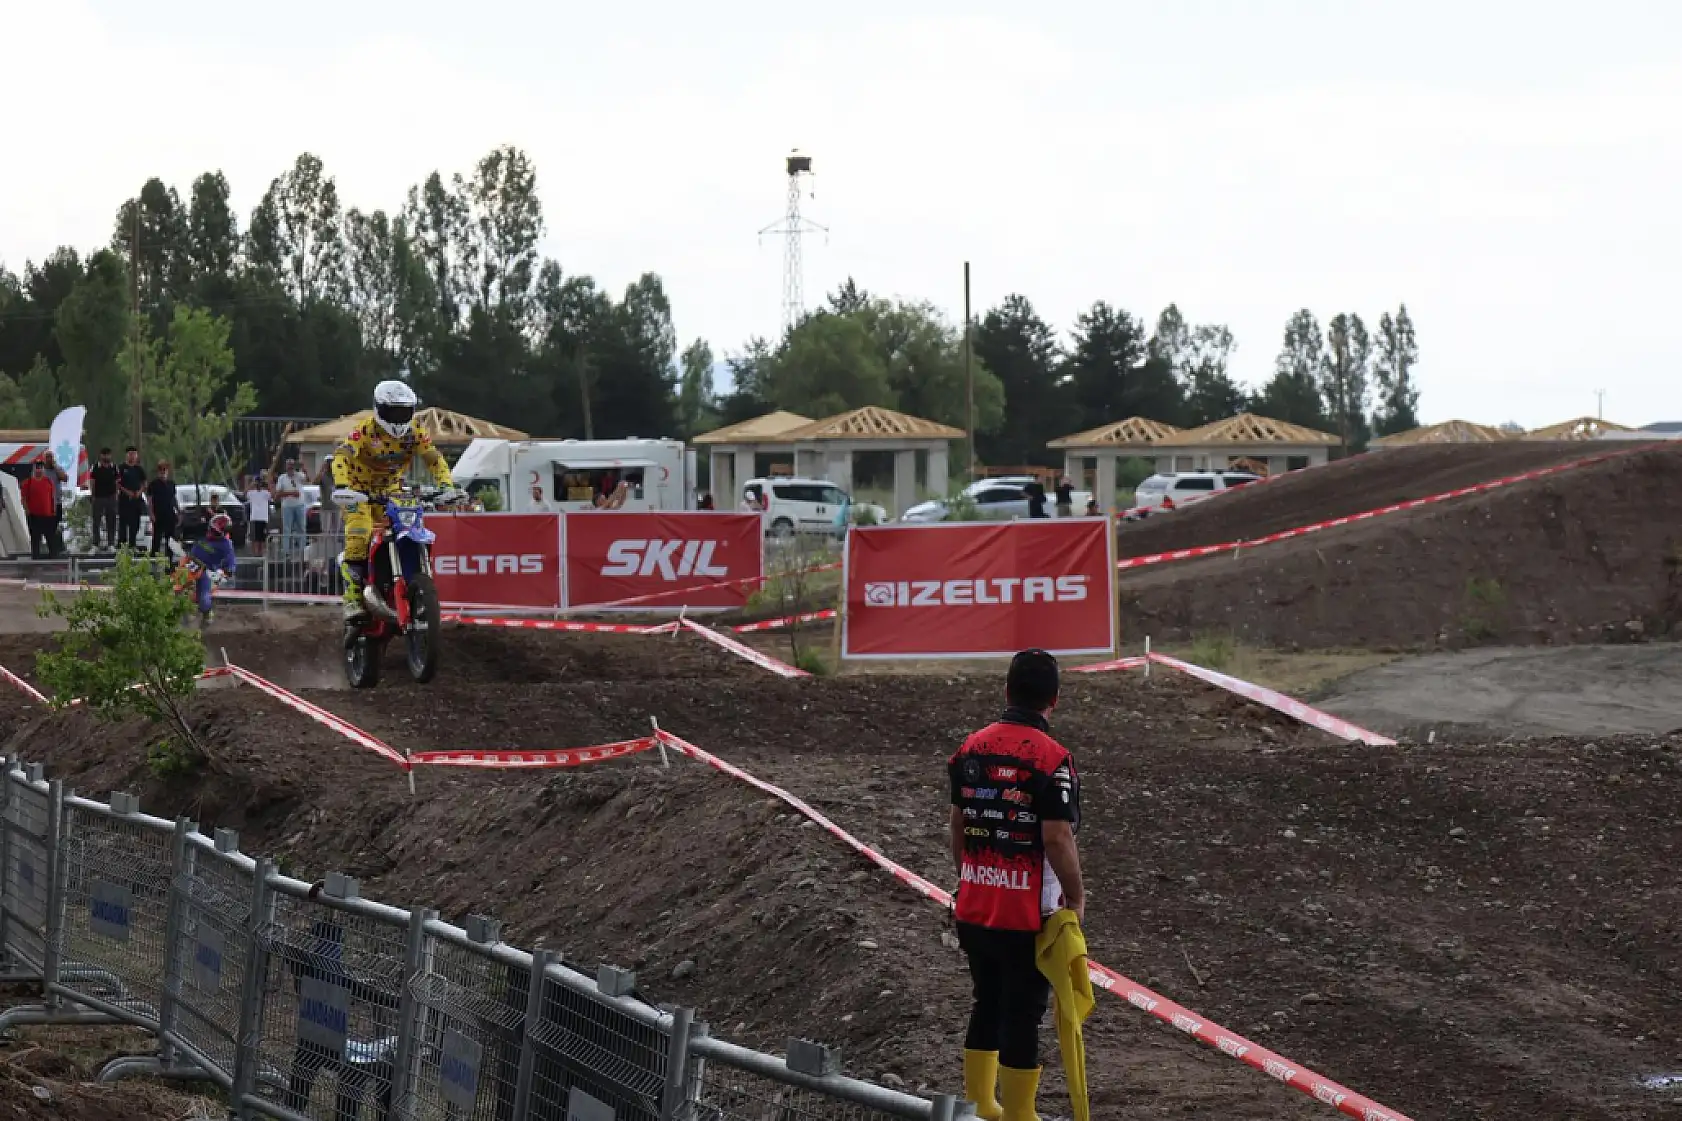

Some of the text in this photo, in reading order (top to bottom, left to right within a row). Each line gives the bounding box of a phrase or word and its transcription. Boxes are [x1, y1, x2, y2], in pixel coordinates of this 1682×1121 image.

[433, 553, 544, 576] ELTAS
[600, 538, 728, 581] SKIL
[896, 574, 1088, 607] IZELTAS
[960, 862, 1031, 890] MARSHALL
